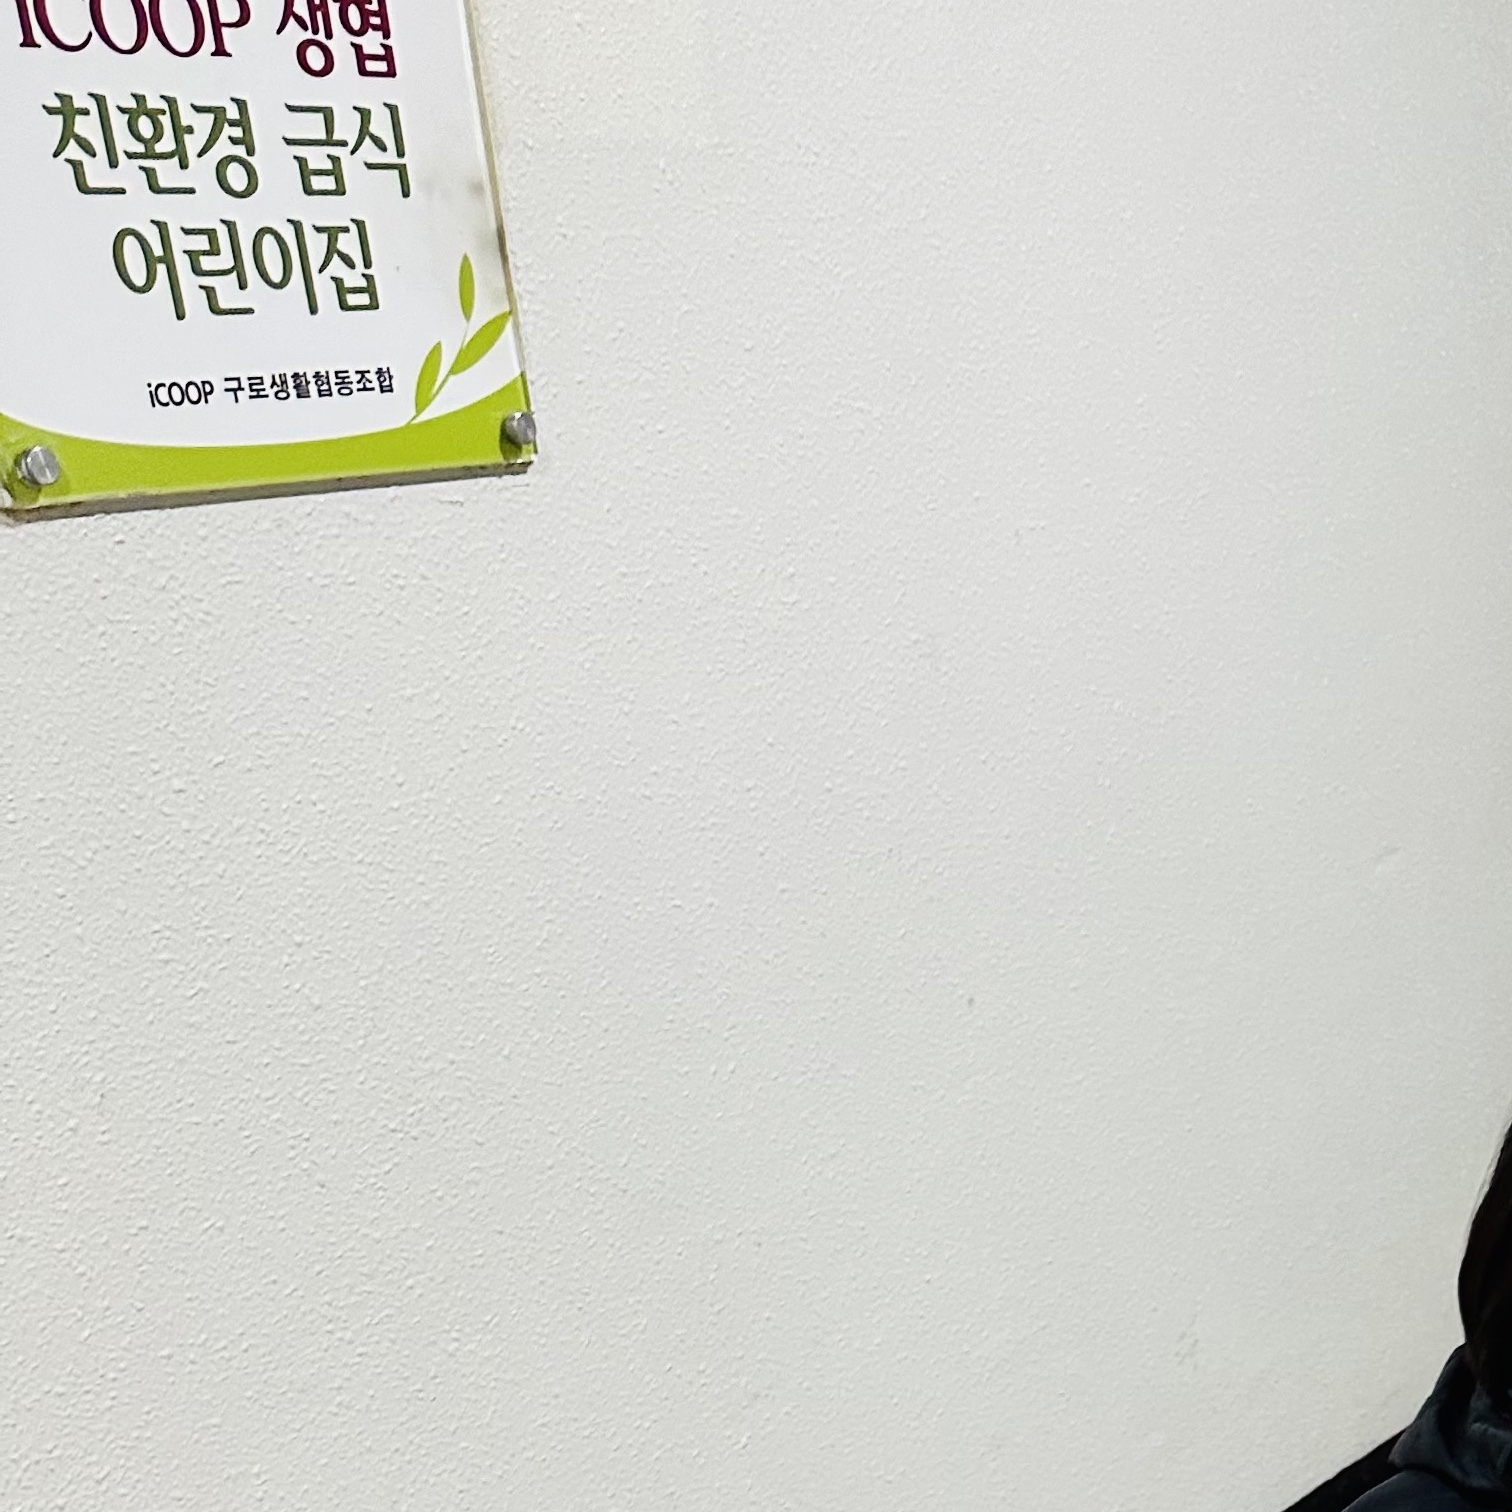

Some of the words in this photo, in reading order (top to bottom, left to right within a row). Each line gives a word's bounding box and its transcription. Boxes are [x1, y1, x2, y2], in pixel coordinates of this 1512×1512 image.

[275, 0, 398, 79] 생협
[41, 91, 259, 199] 친환경
[281, 102, 411, 198] 급식
[112, 218, 380, 321] 어린이집
[147, 380, 215, 408] iCOOP
[223, 366, 395, 404] 구로생활협동조합
